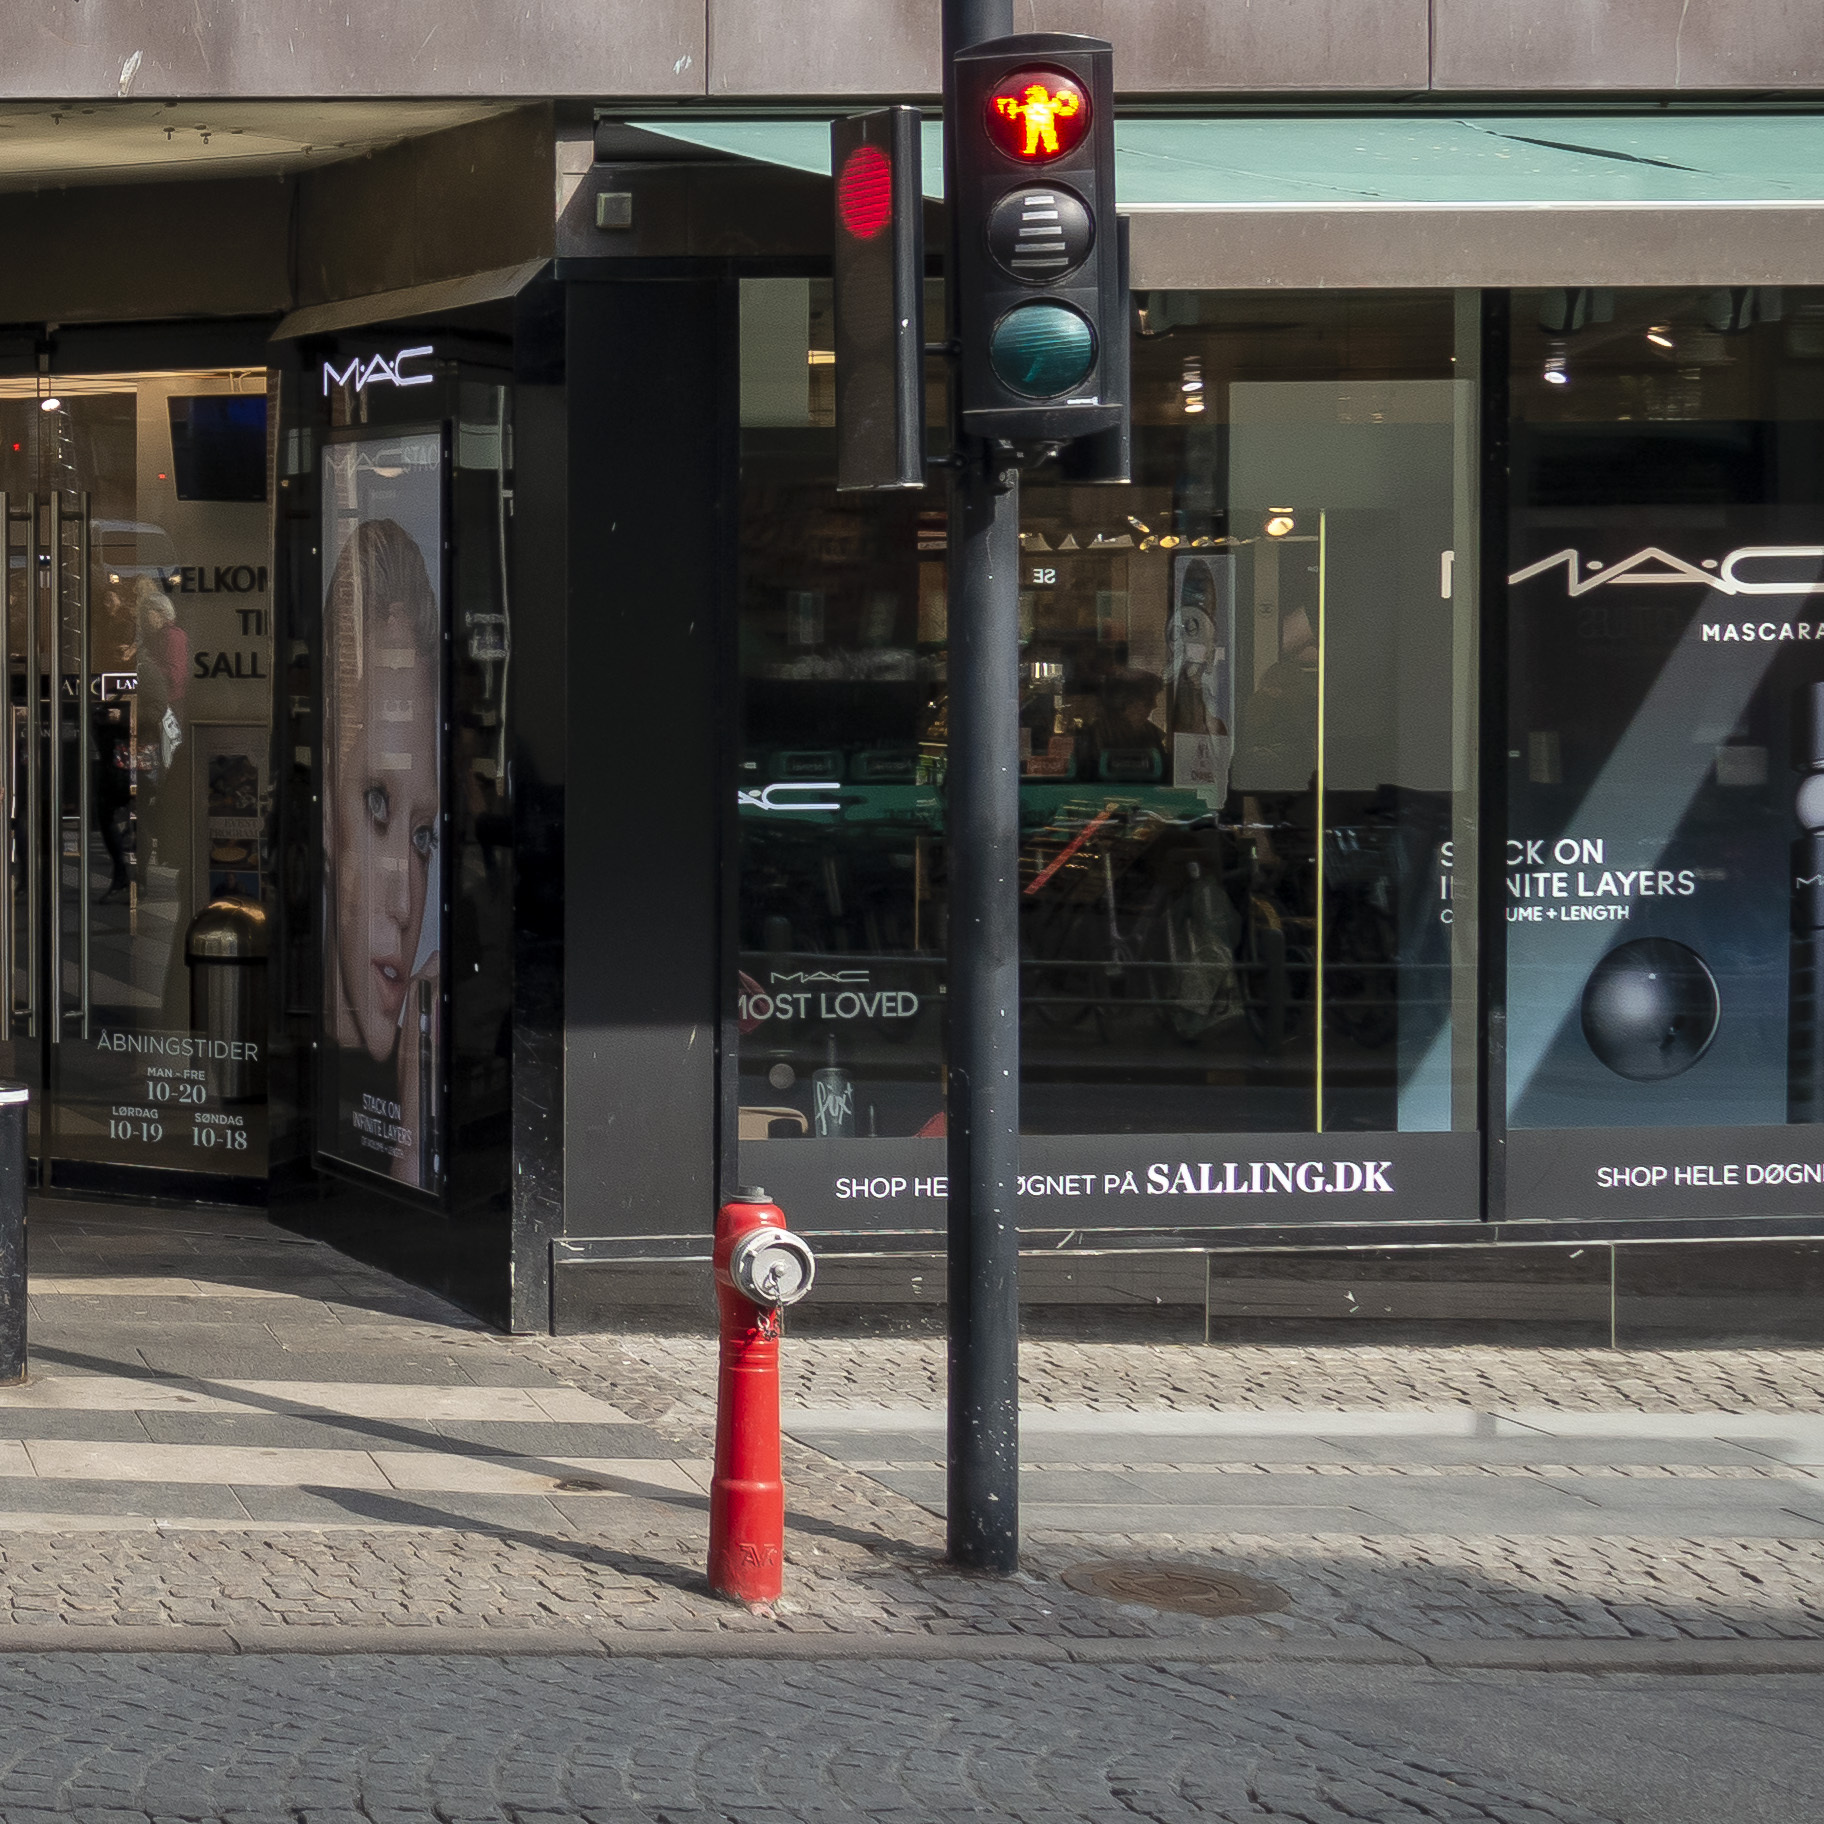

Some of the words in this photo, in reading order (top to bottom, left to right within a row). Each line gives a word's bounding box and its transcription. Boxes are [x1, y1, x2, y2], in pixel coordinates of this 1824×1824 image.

[1553, 838, 1605, 865] ON
[1577, 869, 1696, 897] LAYERS
[1560, 905, 1631, 922] LENGTH
[819, 991, 919, 1019] LOVED
[96, 1028, 259, 1062] ÅBNINGSTIDER
[147, 1066, 173, 1079] MAN
[183, 1069, 206, 1081] FRE
[146, 1080, 207, 1105] 10-20
[111, 1105, 159, 1120] LØRDAG
[194, 1112, 244, 1127] SØNDAG
[109, 1119, 164, 1143] 10-19
[192, 1126, 248, 1151] 10-18
[835, 1177, 907, 1198] SHOP
[1104, 1170, 1141, 1195] PÅ
[1146, 1161, 1394, 1195] SALLING.DK
[1596, 1166, 1668, 1189] SHOP
[1674, 1165, 1740, 1187] HELE
[1746, 1163, 1824, 1185] DØGN
